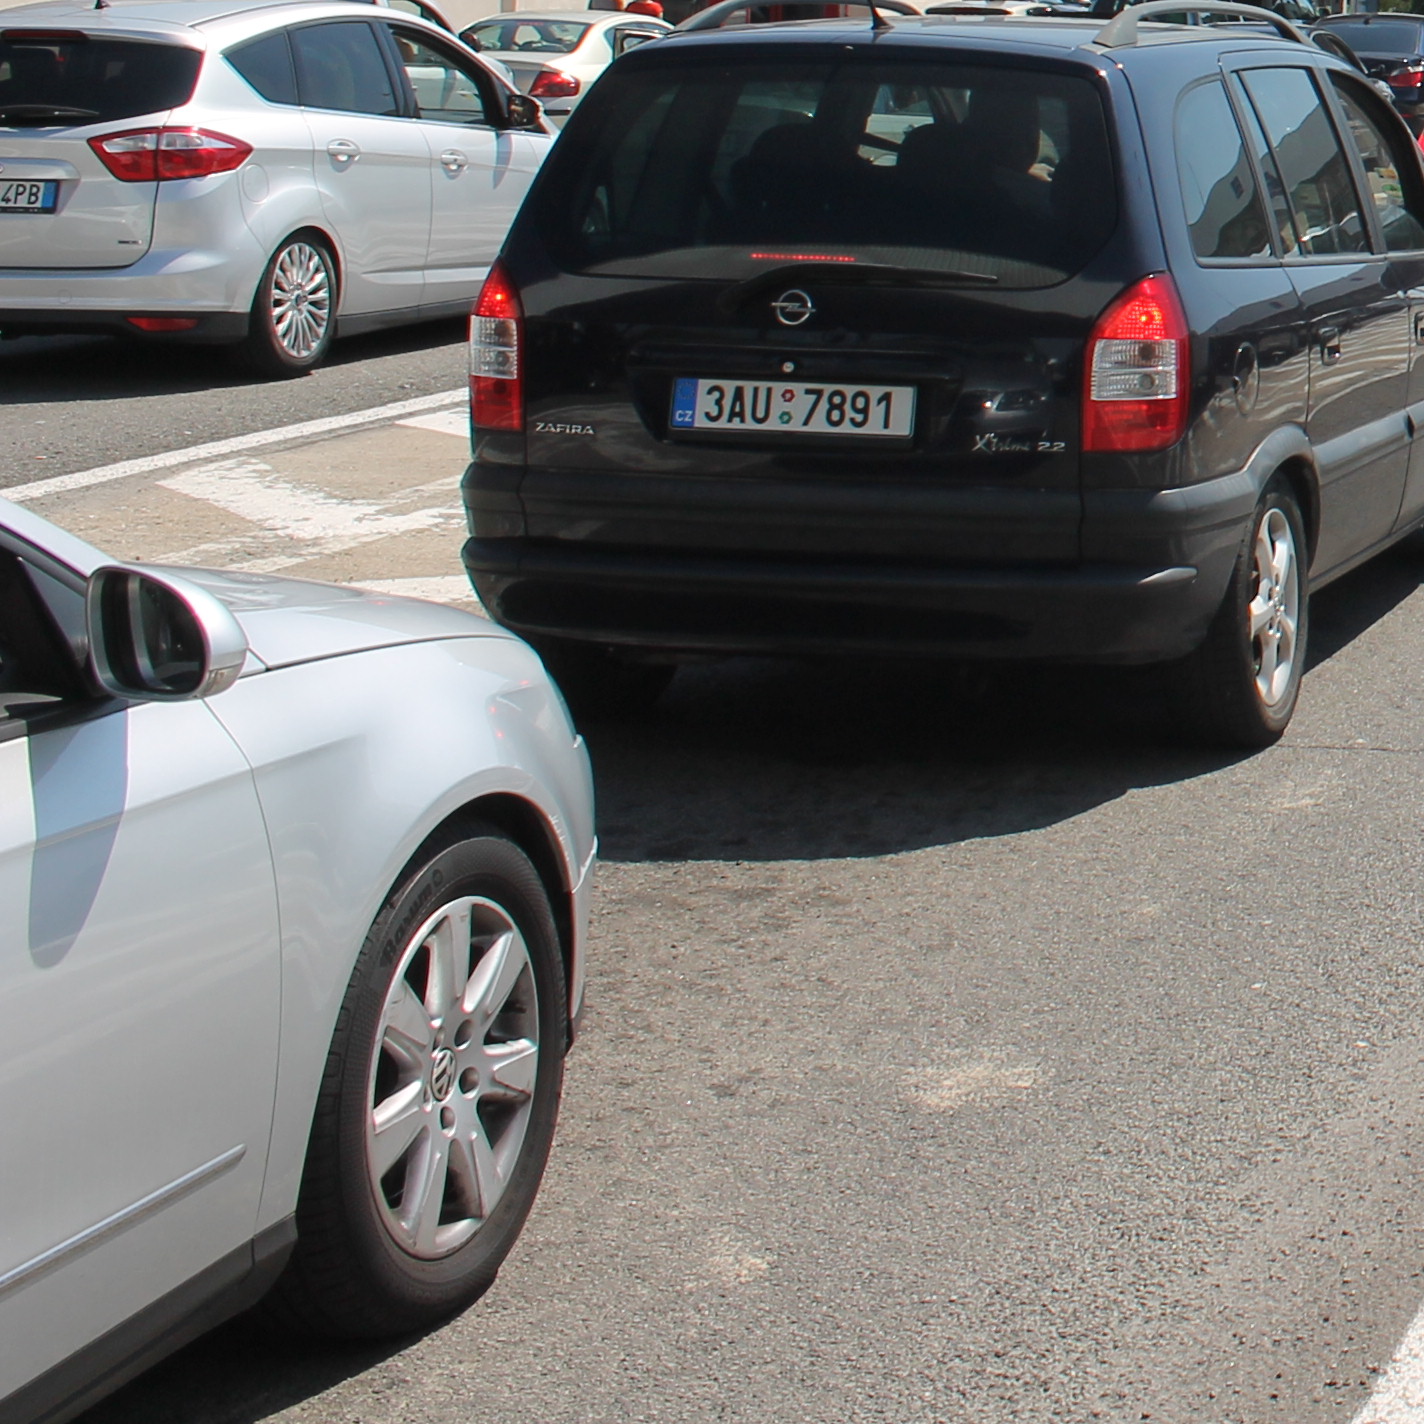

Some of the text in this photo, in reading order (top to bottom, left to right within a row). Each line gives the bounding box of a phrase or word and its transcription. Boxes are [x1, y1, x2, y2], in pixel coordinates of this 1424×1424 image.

[703, 384, 893, 430] 3AU 7891
[675, 410, 693, 422] CZ
[535, 422, 595, 435] ZAFIRA
